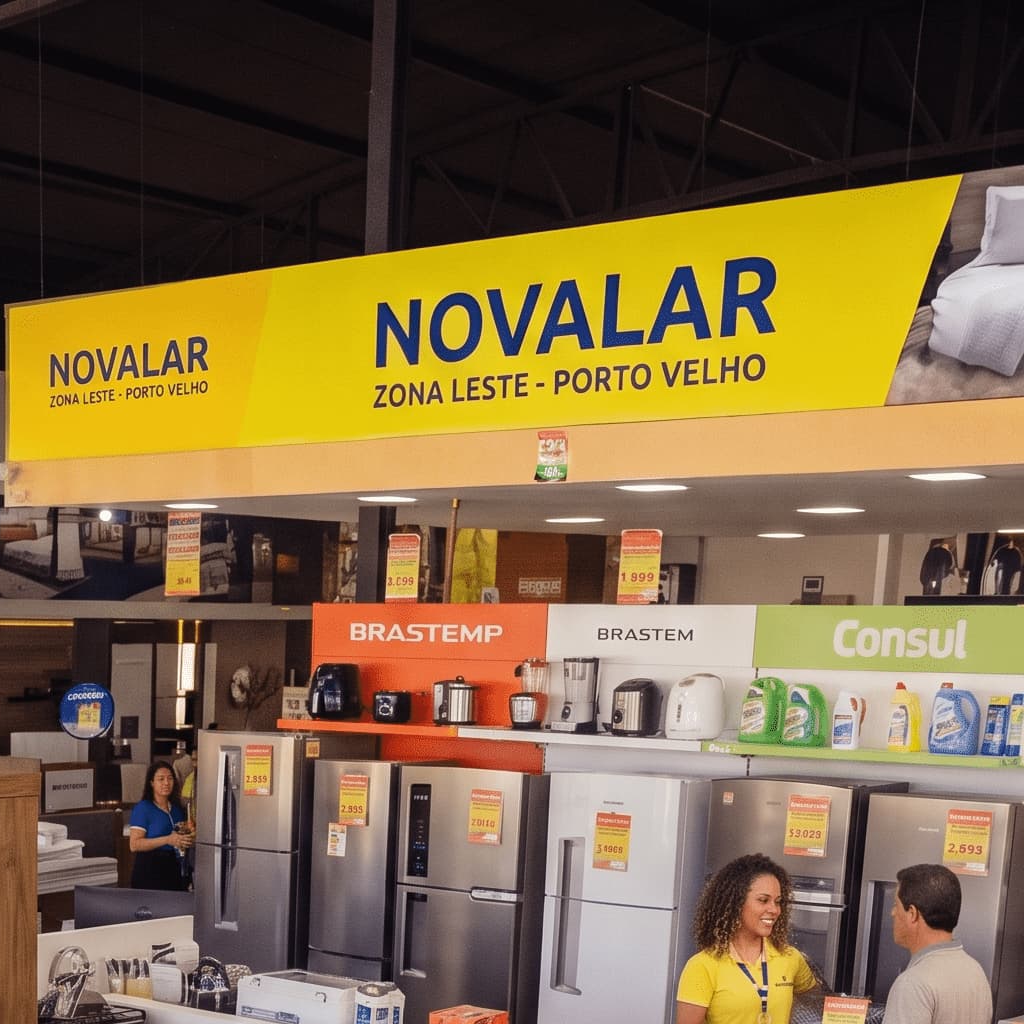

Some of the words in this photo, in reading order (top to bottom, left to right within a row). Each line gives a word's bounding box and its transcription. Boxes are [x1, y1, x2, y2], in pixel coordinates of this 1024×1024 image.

[375, 256, 777, 369] NOVALAR
[49, 336, 209, 388] NOVALAR
[373, 381, 444, 409] ZONA
[451, 372, 529, 403] LESTE
[553, 363, 652, 396] PORTO
[661, 353, 767, 388] VELHO
[49, 393, 80, 408] ZONA
[83, 389, 116, 405] LESTE
[125, 384, 164, 400] PORTO
[168, 380, 209, 396] VELHO
[349, 622, 504, 644] BRASTEMP
[597, 628, 694, 641] BRASTEM
[833, 619, 968, 660] Consul
